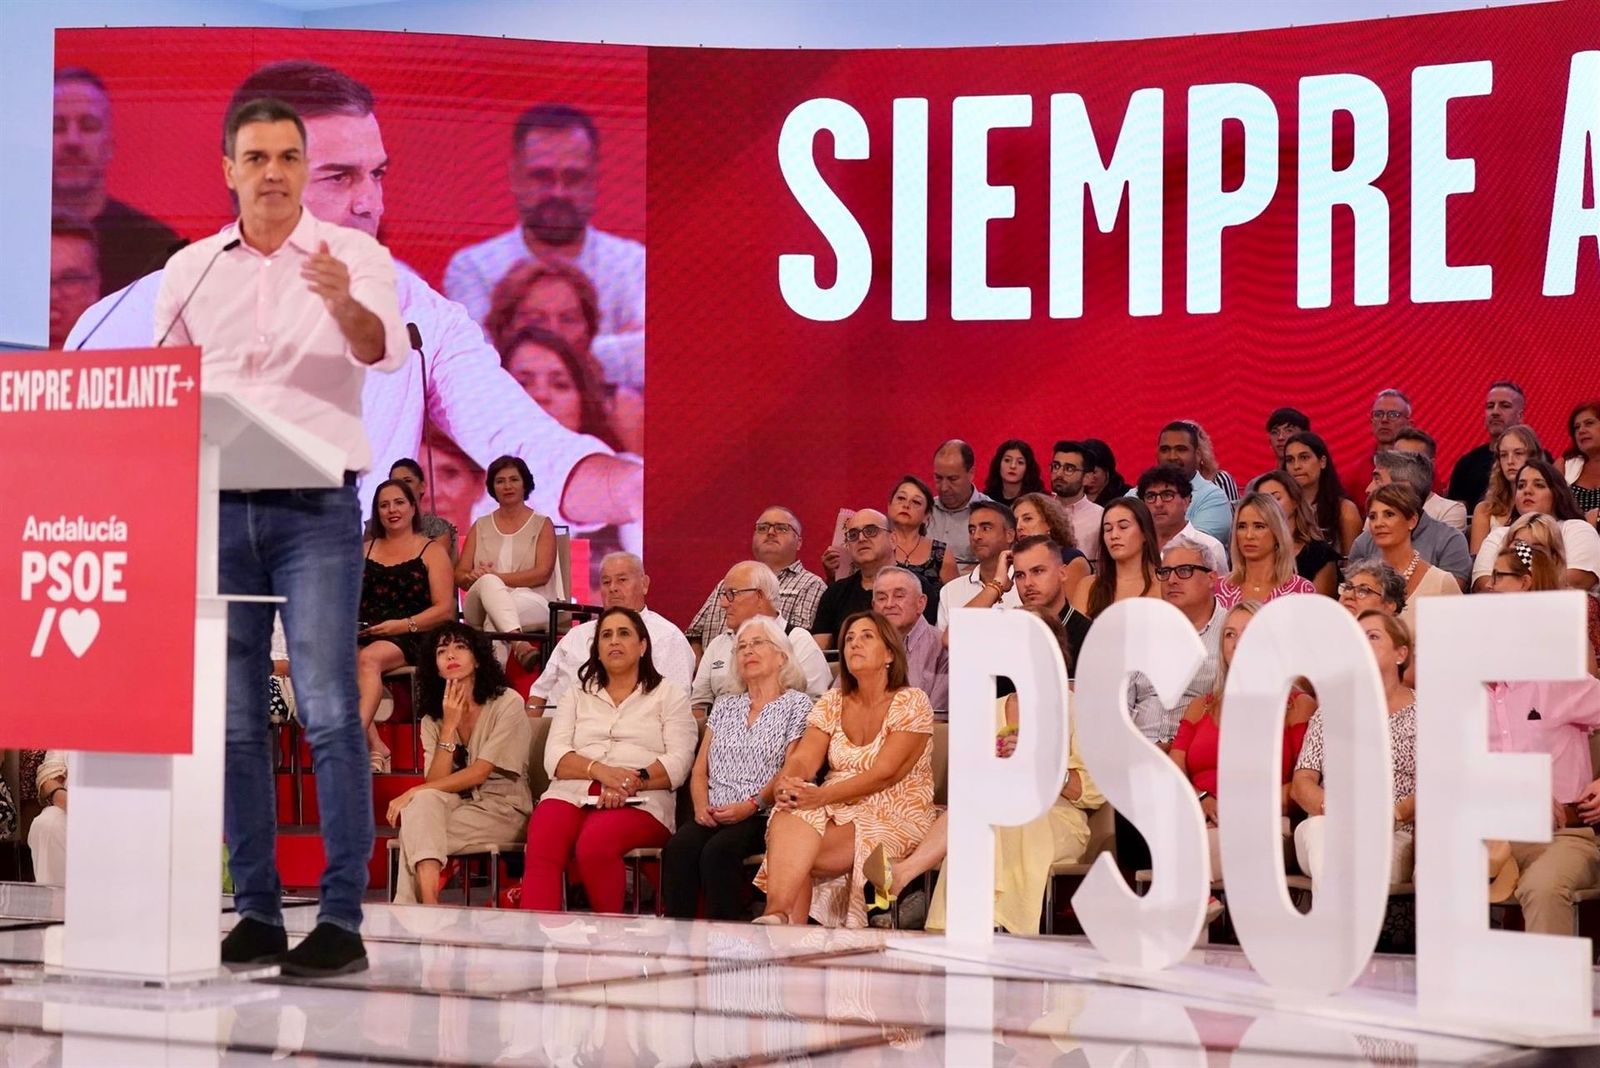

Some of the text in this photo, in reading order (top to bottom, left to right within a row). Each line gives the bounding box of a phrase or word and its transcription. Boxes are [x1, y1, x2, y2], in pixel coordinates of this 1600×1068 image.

[777, 60, 1494, 322] SIEMPRE
[0, 364, 181, 413] EMPRE ADELANTE
[22, 515, 128, 542] Andalucía
[21, 550, 128, 603] PSOE
[944, 590, 1593, 1030] PSOE
